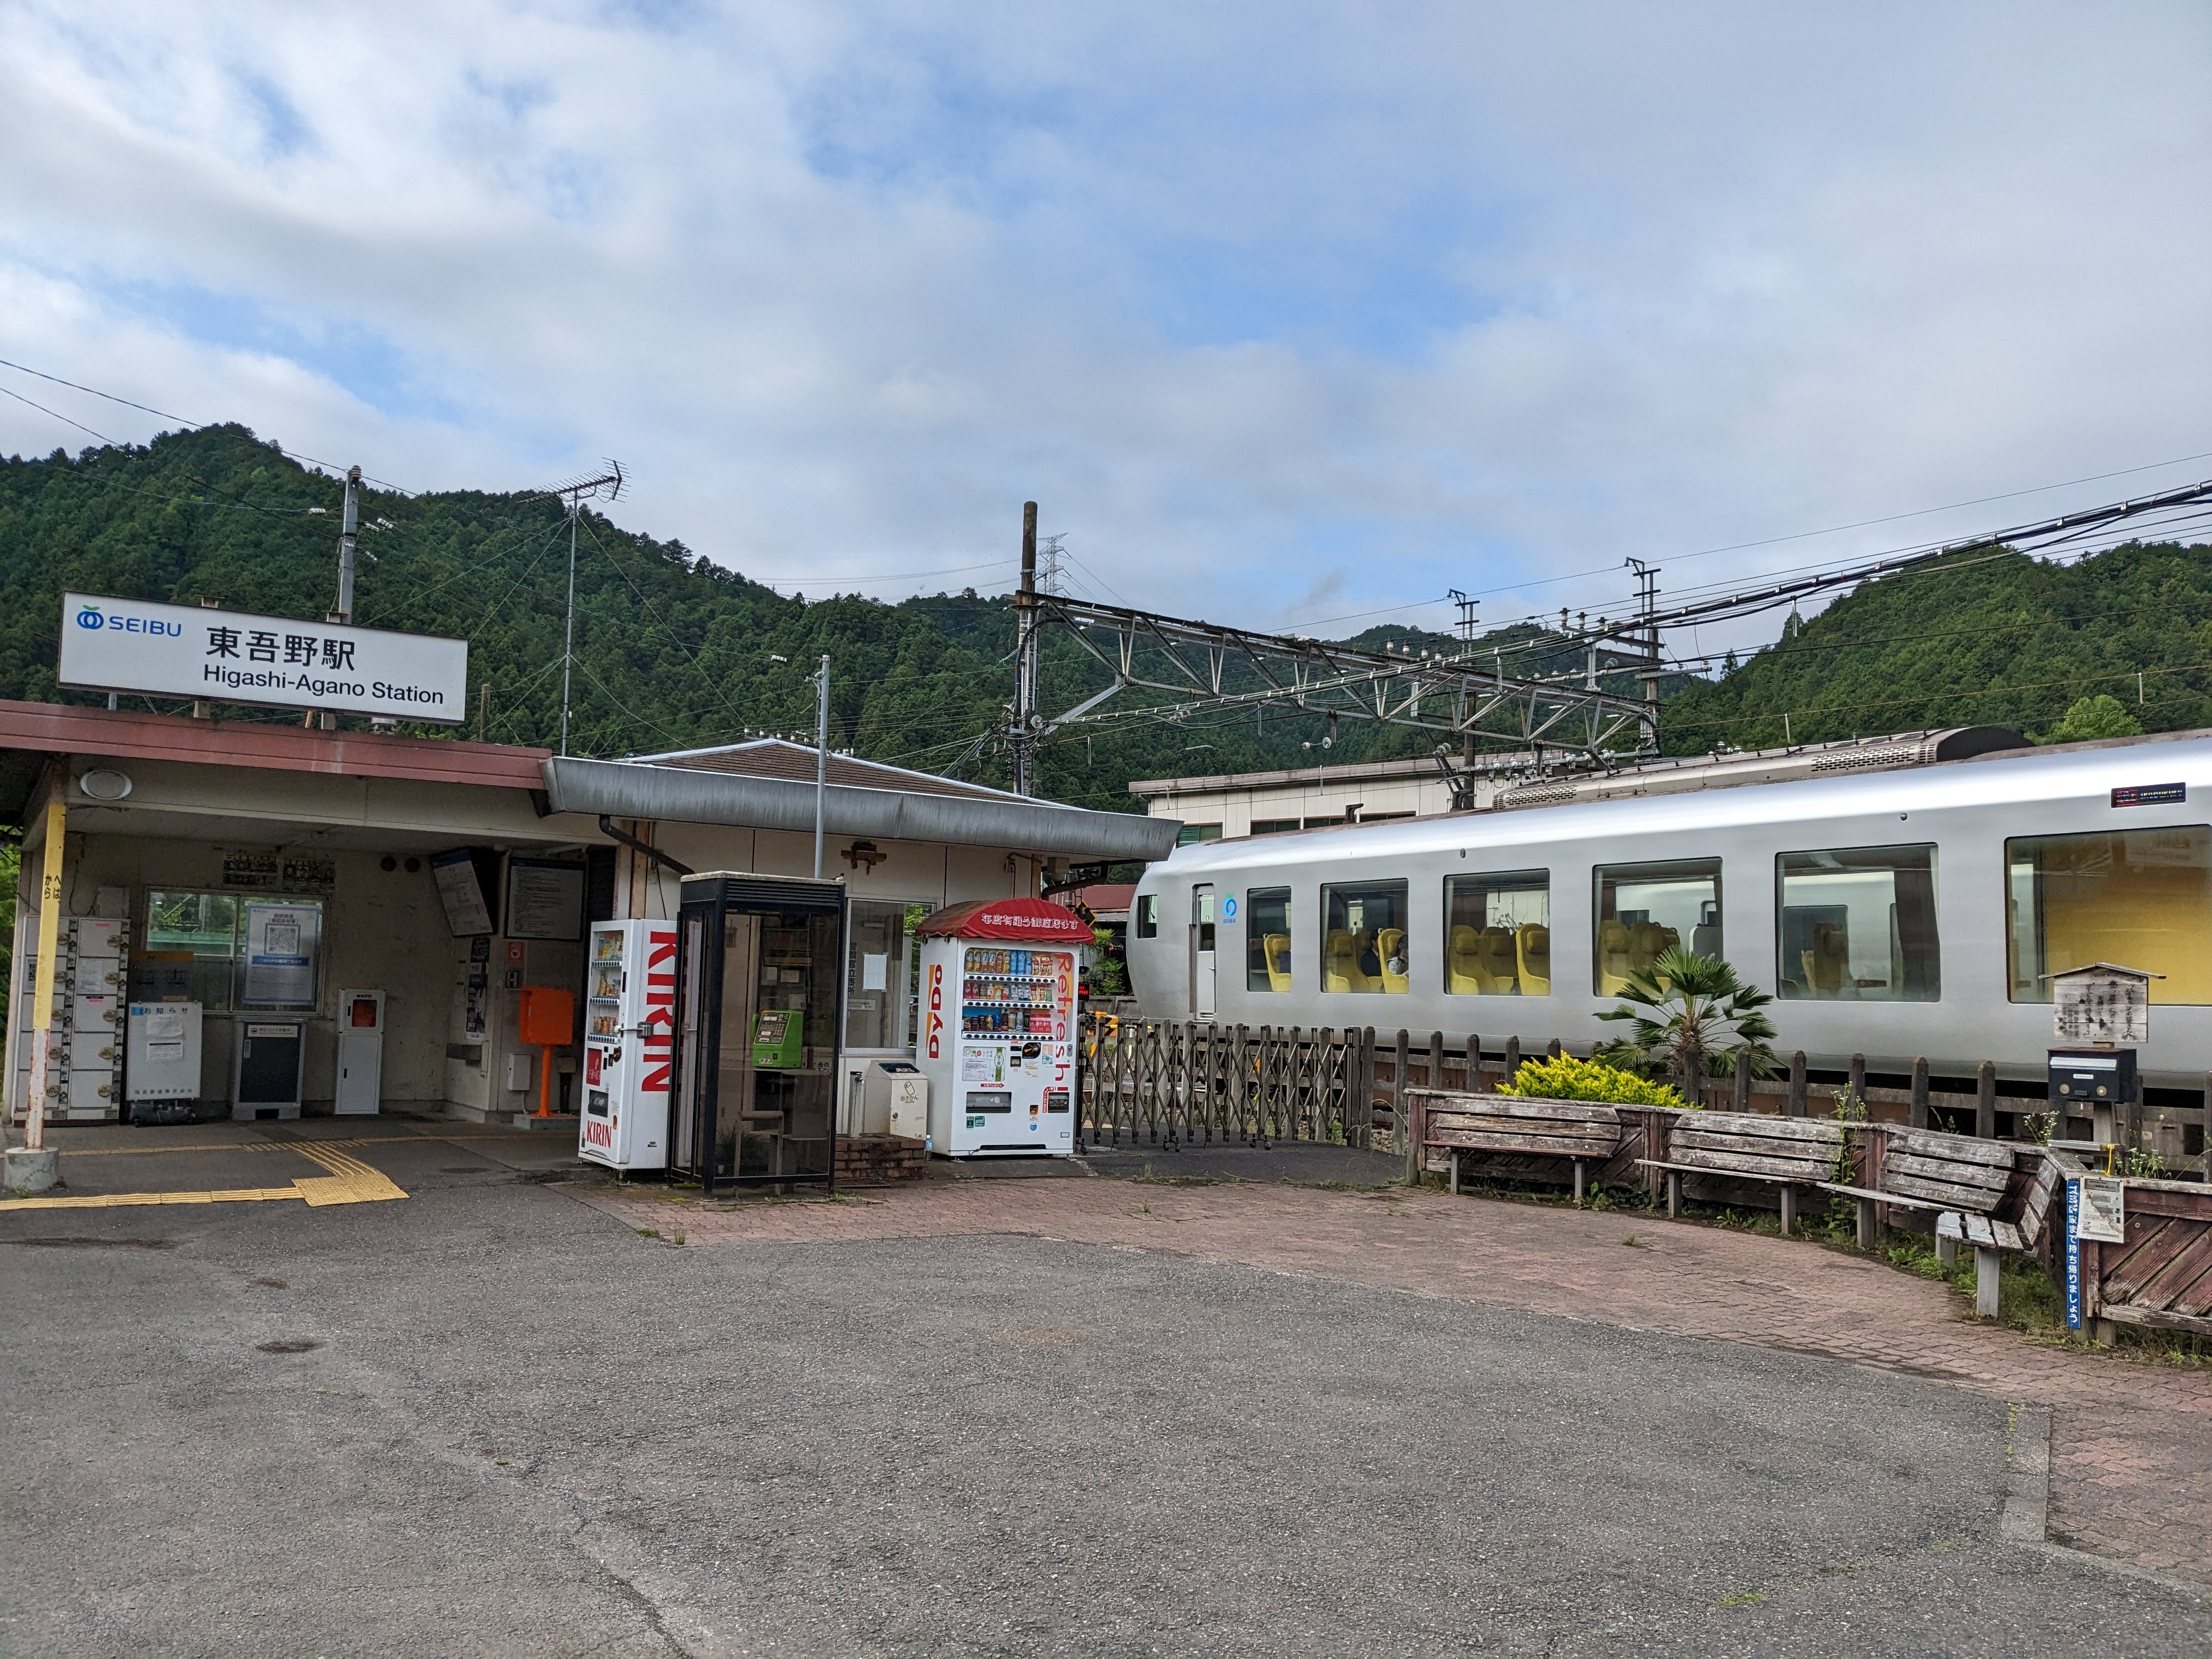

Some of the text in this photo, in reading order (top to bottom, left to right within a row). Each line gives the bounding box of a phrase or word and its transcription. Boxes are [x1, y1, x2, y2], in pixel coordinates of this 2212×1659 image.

[109, 616, 182, 637] SEIBU
[205, 626, 356, 672] 東吾野駅
[204, 664, 443, 704] Higashi-Agano Station
[45, 874, 52, 899] から
[1054, 953, 1074, 1091] Refresh!
[586, 1120, 612, 1149] KIRIN
